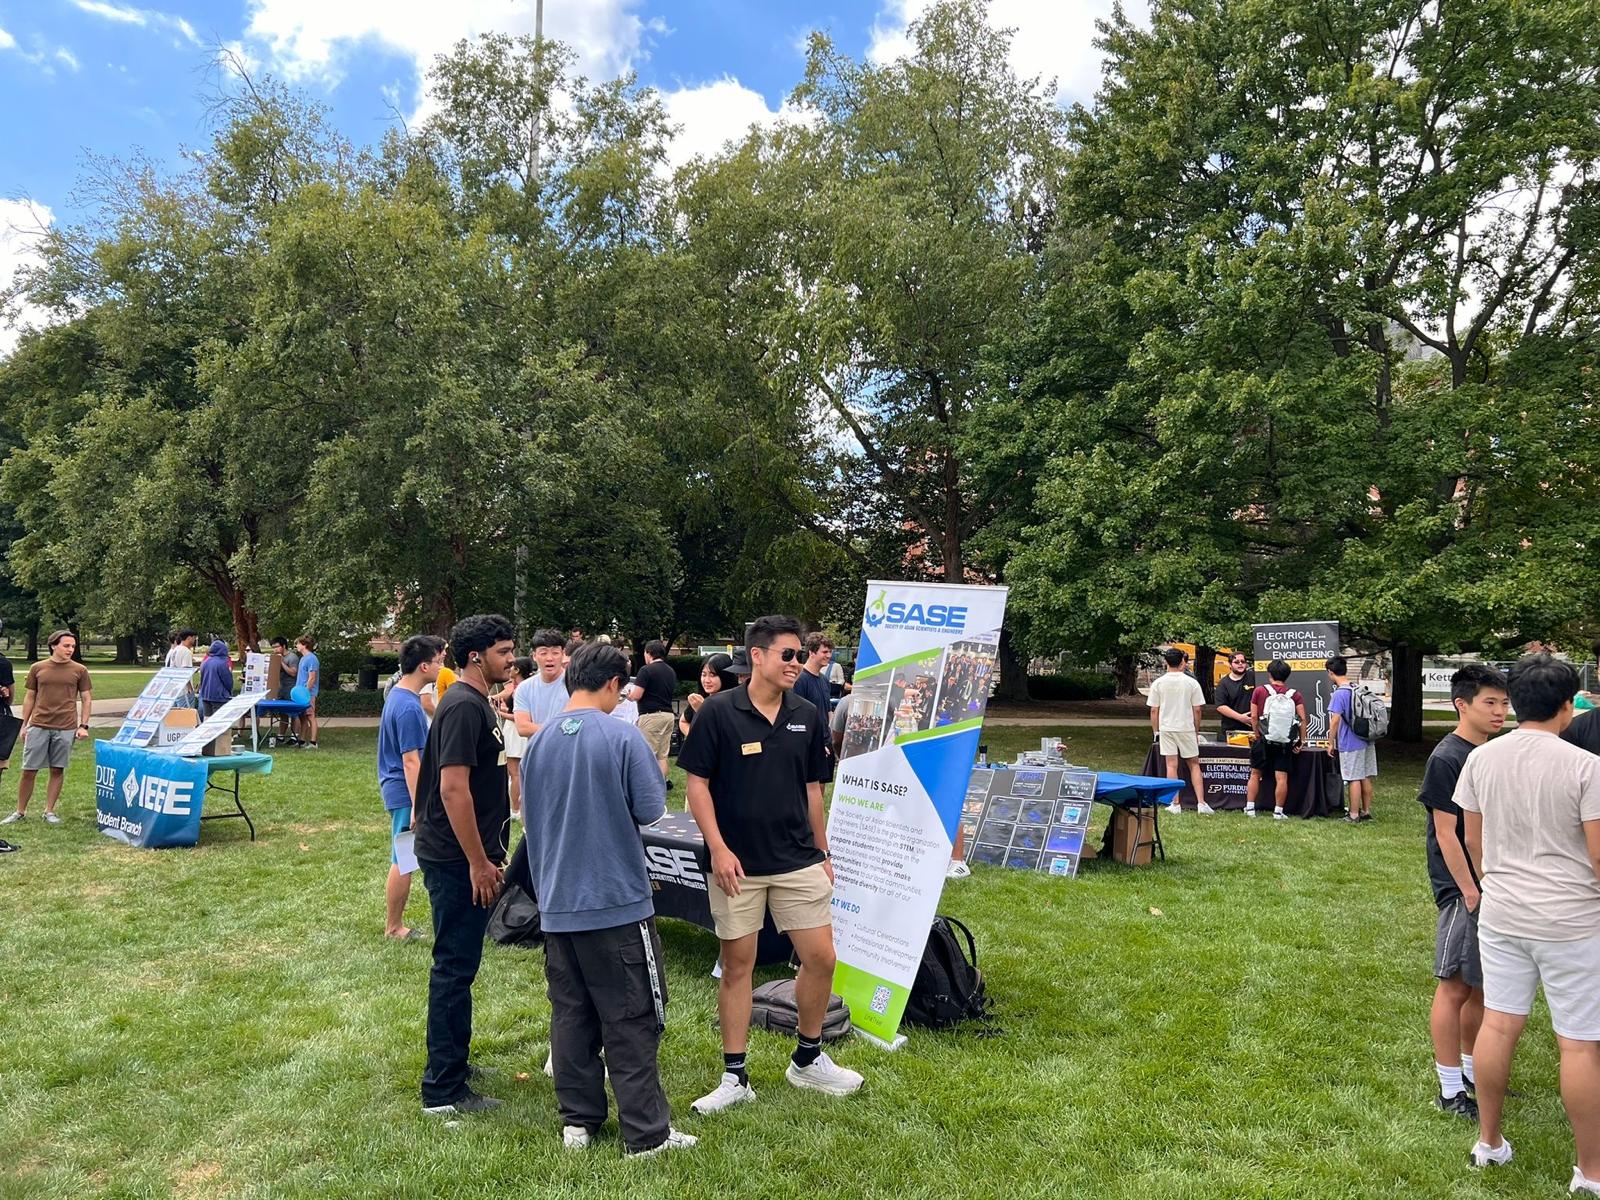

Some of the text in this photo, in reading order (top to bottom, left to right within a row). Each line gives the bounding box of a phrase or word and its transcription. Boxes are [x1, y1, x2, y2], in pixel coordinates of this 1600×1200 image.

[886, 602, 968, 628] SASE
[1256, 631, 1317, 641] ELECTRICAL
[1264, 640, 1326, 650] COMPUTER
[1272, 650, 1335, 660] ENGINEERING
[1299, 661, 1326, 670] SOCIE
[1429, 672, 1452, 682] Kett
[96, 765, 116, 787] DUE
[1202, 771, 1249, 780] MPUTER ENGINEE
[1206, 764, 1239, 772] ELECTRICAL
[842, 774, 908, 796] WHAT IS SASE?
[138, 774, 194, 815] IEEE
[839, 793, 885, 811] WHO WE ARE
[845, 810, 864, 821] Society
[120, 816, 143, 837] Branch
[831, 834, 851, 845] prepare
[852, 840, 874, 851] students
[645, 846, 705, 882] SE
[829, 852, 861, 867] portunities
[894, 870, 911, 880] make
[832, 863, 859, 876] ntributions
[882, 857, 903, 869] provide
[835, 873, 858, 885] celebrate
[859, 881, 878, 892] diversity
[831, 897, 860, 914] AT WE DO
